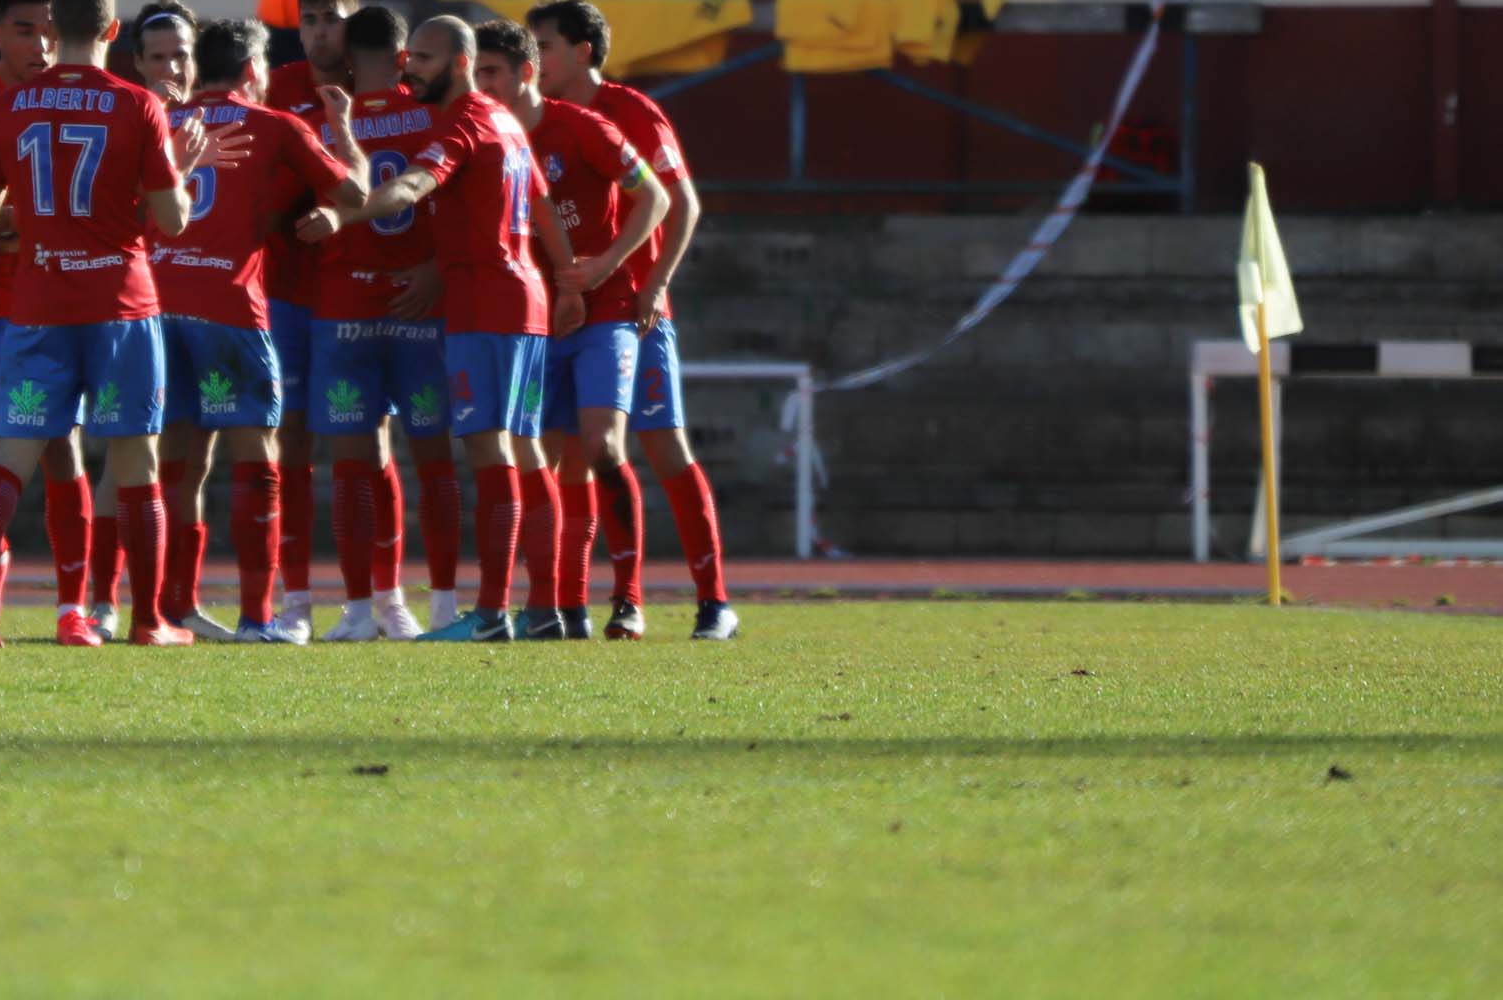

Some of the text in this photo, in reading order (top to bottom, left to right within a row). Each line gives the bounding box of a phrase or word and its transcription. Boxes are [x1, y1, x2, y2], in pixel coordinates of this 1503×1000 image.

[11, 87, 116, 114] ALBERTO
[17, 122, 107, 217] 17
[200, 399, 237, 415] Soria
[328, 407, 365, 424] Soria
[7, 408, 46, 427] Soria
